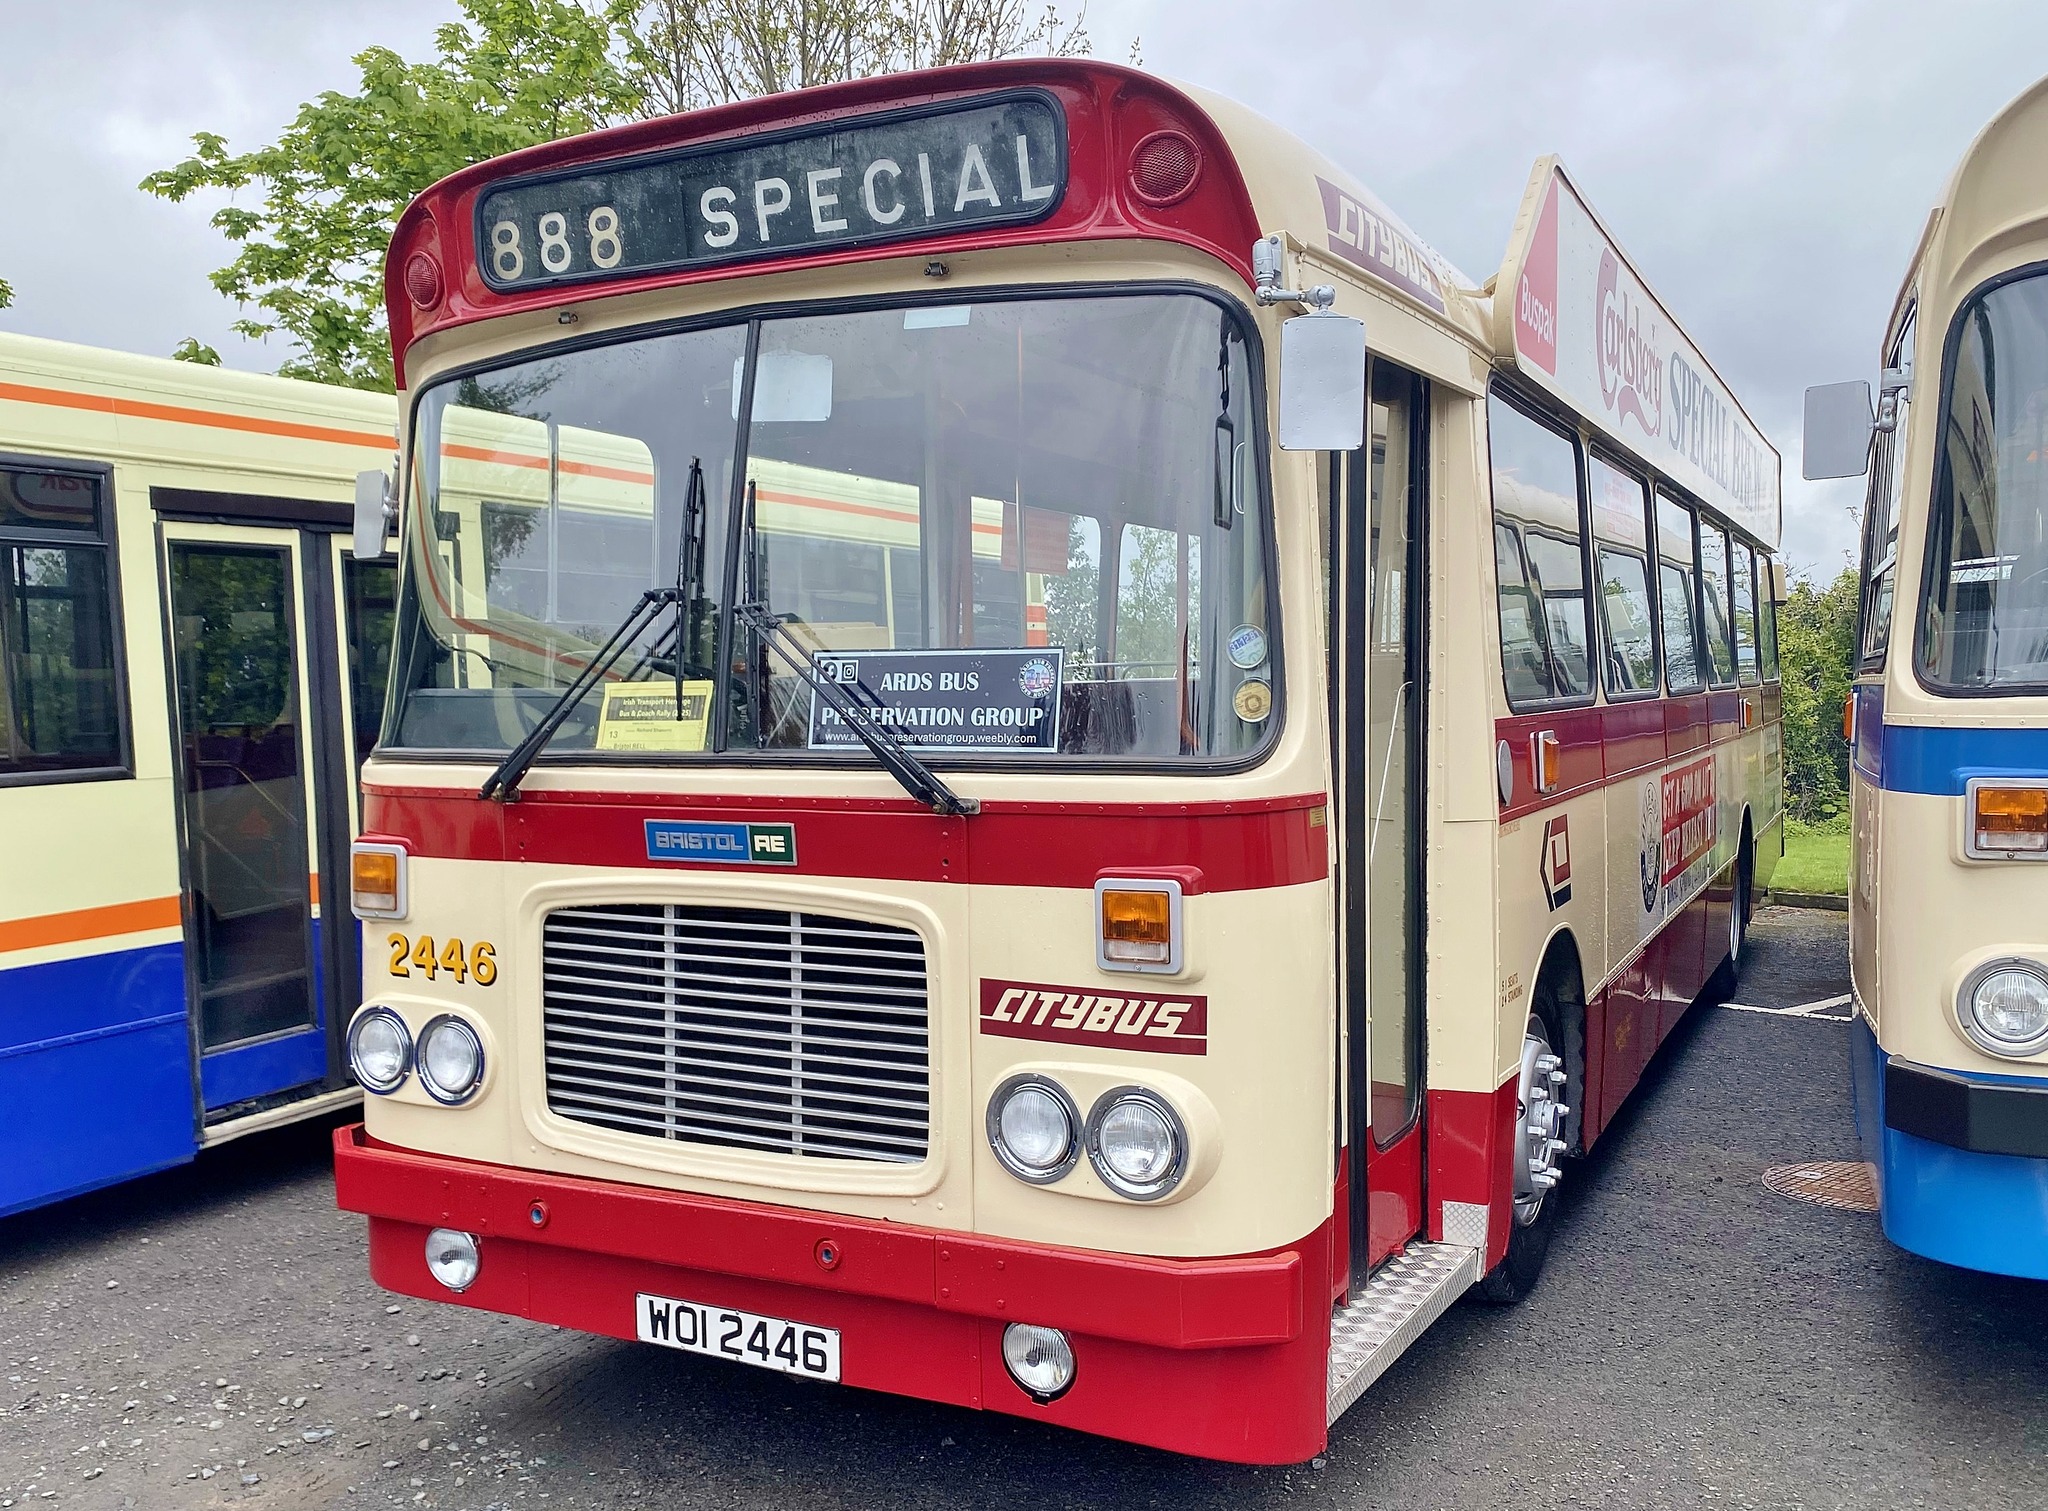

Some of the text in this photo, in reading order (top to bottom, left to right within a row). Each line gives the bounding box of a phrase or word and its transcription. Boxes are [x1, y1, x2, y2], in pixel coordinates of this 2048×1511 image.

[491, 134, 1054, 280] 888 SPECIAL
[1338, 194, 1432, 292] CITYBUS
[1521, 273, 1554, 347] Buspak
[1595, 247, 1663, 437] Carlsberg
[1668, 351, 1727, 491] SPECIAL
[637, 699, 664, 707] Transport
[880, 672, 979, 691] ARDS BUS
[609, 730, 619, 739] 13
[656, 709, 671, 718] Rally
[970, 707, 1044, 726] GROUP
[655, 831, 744, 851] BRISTOL
[387, 932, 498, 987] 2446
[991, 988, 1193, 1037] CITYBUS
[648, 1299, 827, 1374] WOI 2446
